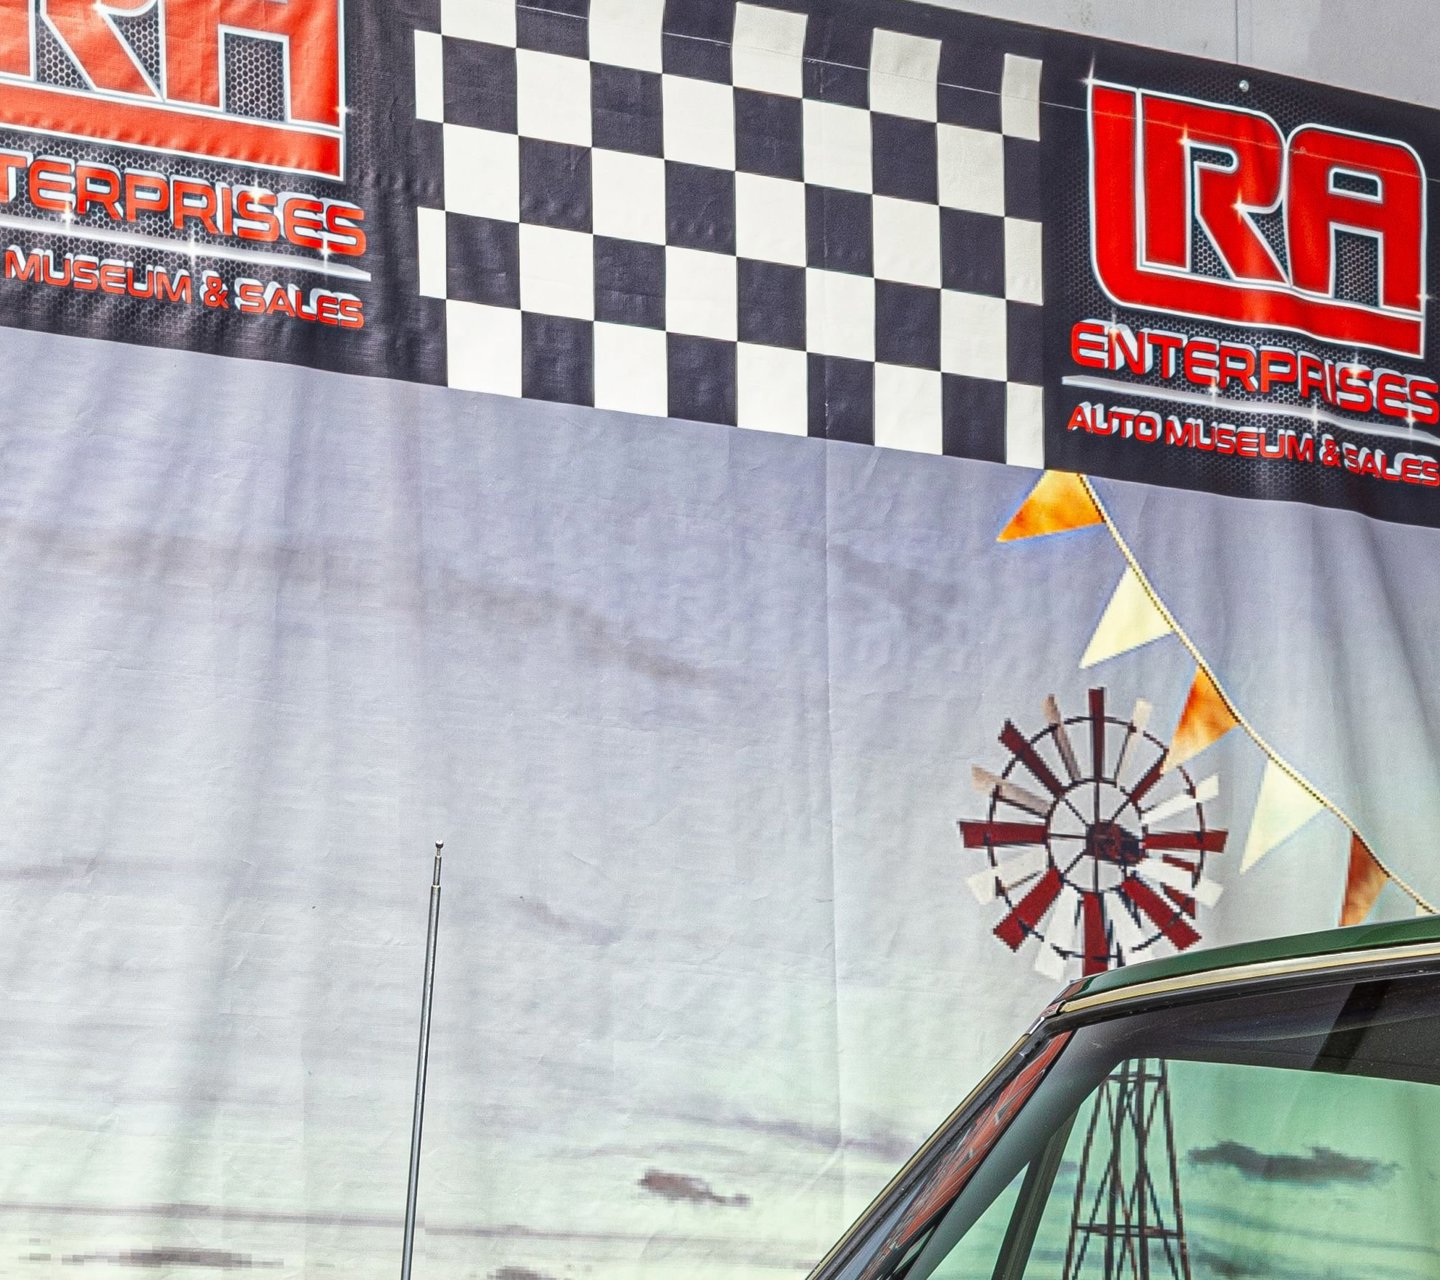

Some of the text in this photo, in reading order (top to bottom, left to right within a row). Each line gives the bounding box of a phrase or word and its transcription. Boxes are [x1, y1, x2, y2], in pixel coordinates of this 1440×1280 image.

[5, 246, 193, 305] MUSEUM
[200, 272, 230, 311] &
[235, 278, 366, 329] SALES
[1067, 400, 1162, 444] AUTO
[1165, 416, 1315, 464] MUSEUM
[1319, 432, 1341, 468] &
